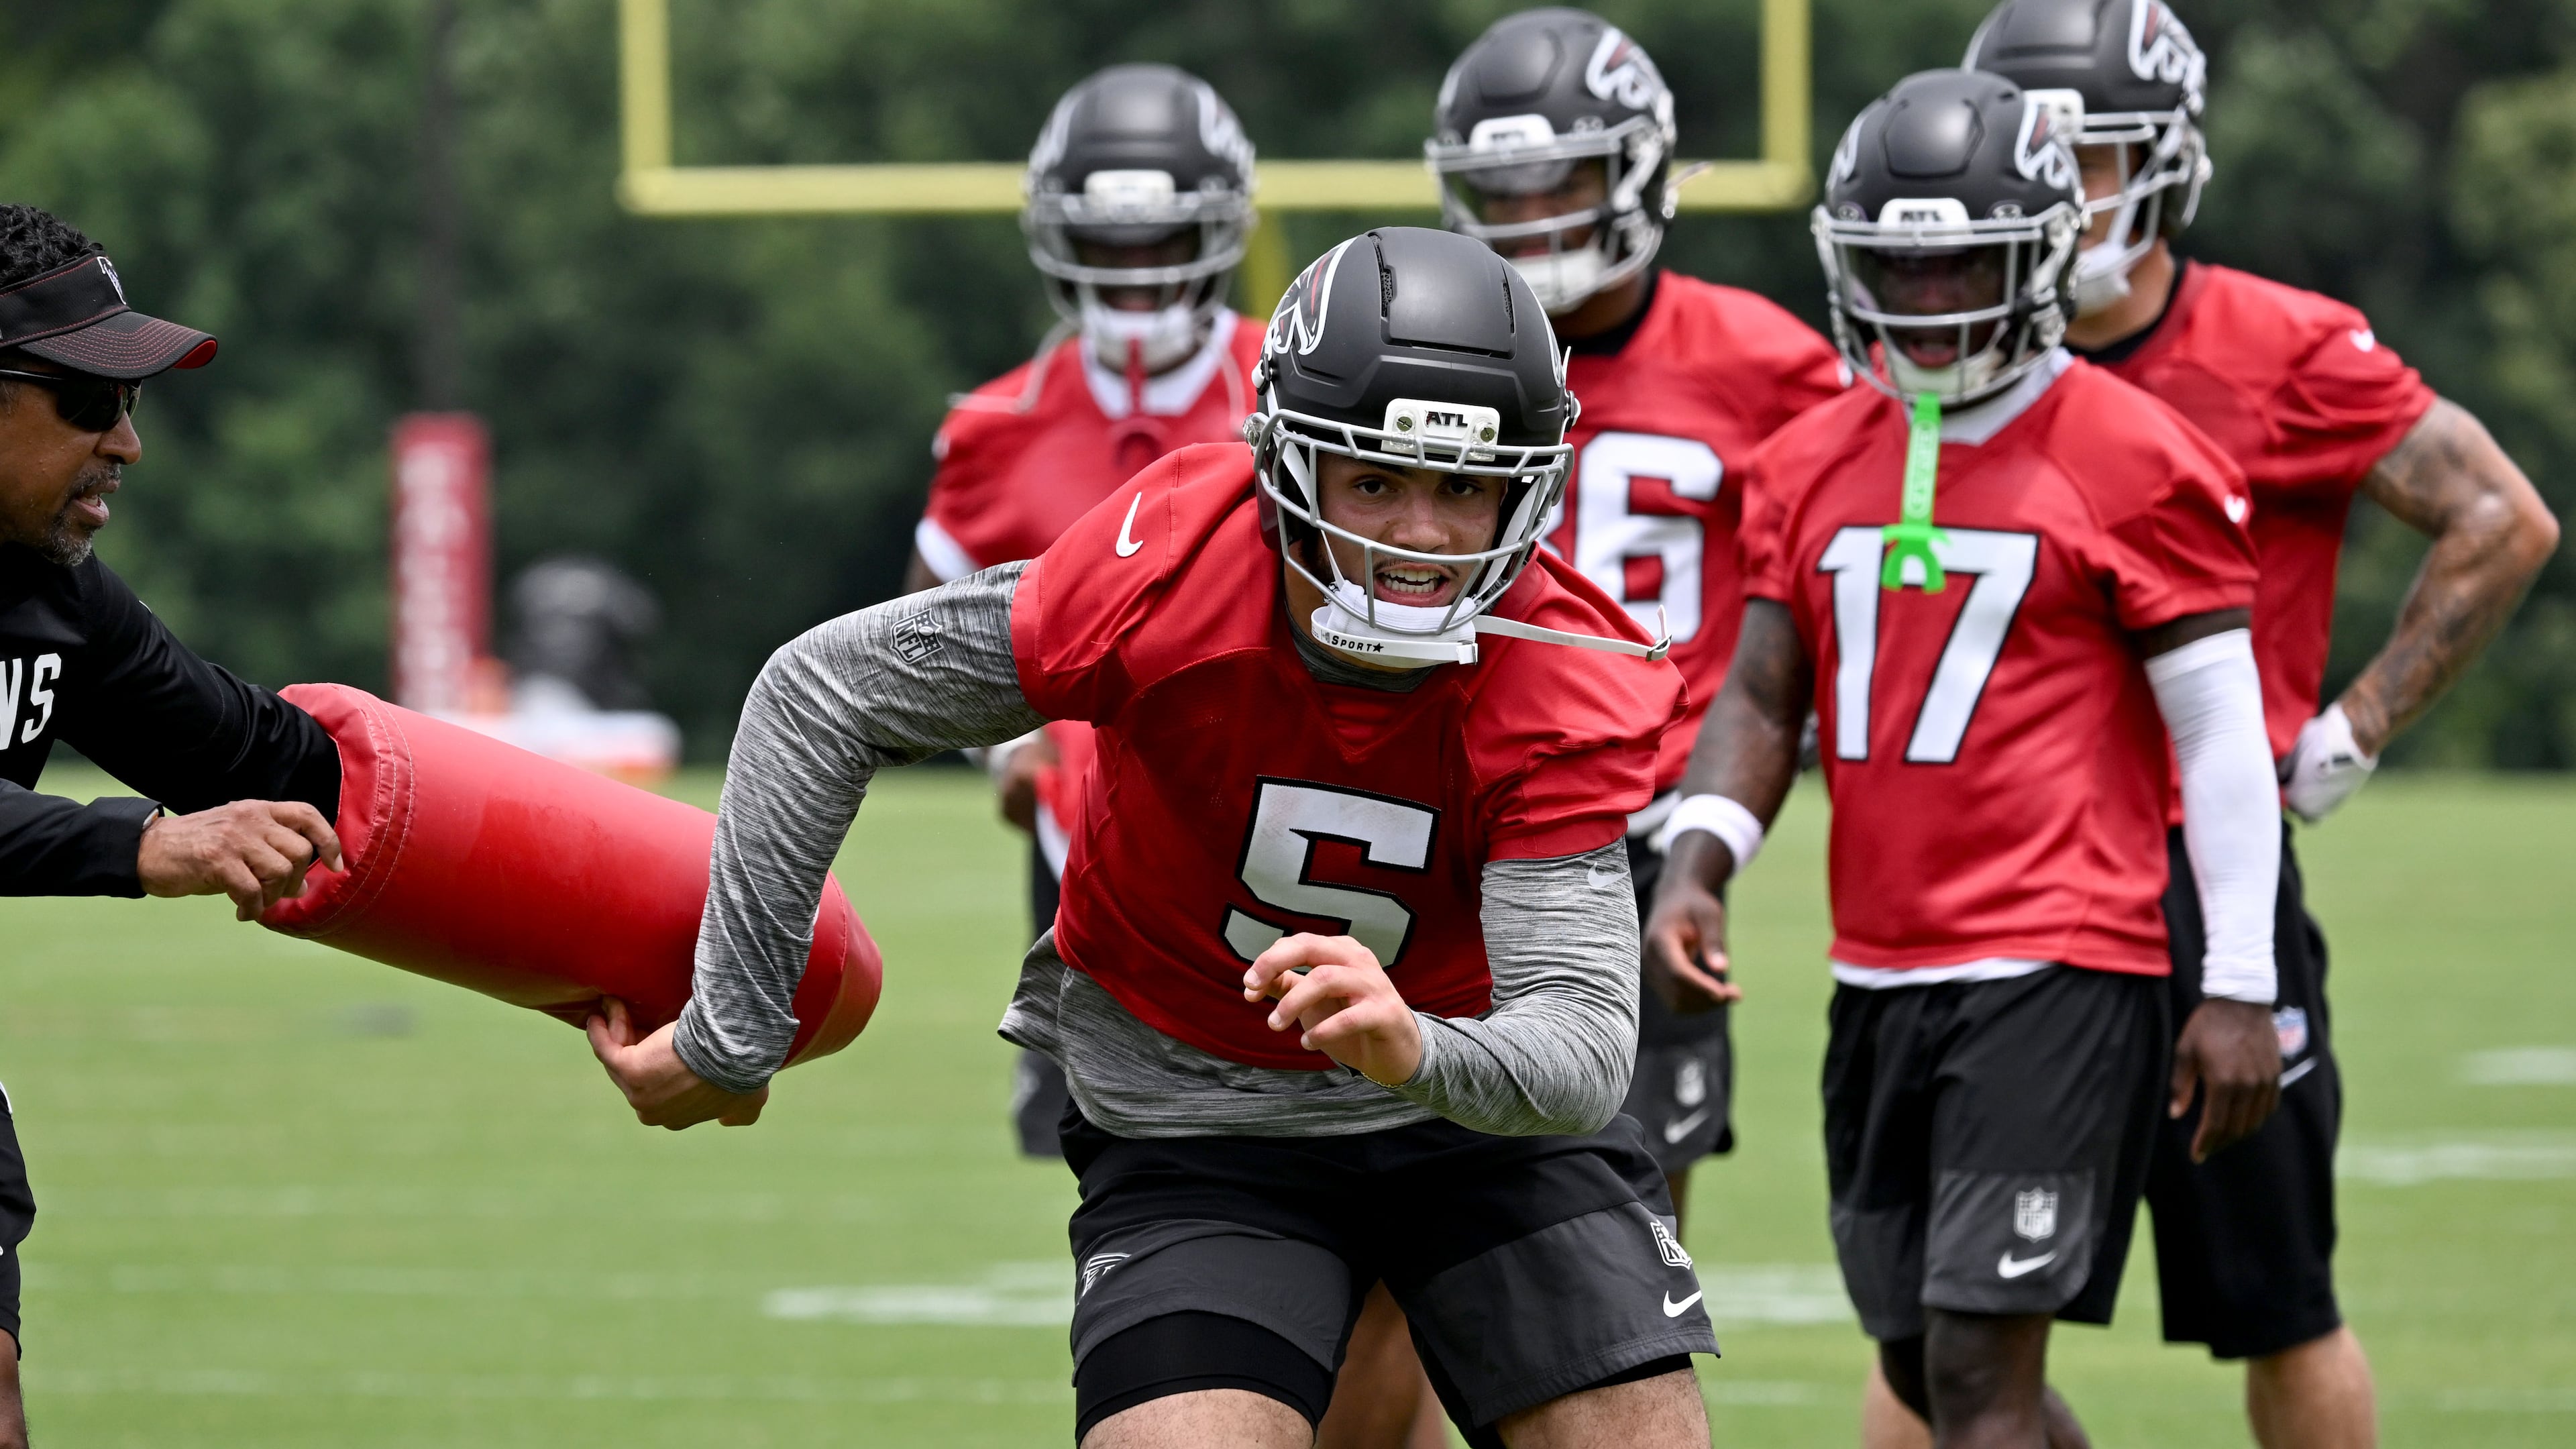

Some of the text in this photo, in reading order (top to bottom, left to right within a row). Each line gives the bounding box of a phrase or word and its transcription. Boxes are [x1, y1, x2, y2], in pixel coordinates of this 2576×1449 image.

[1424, 410, 1468, 427] ATL
[895, 619, 922, 659] NFL
[1816, 525, 2039, 765] 17
[1218, 774, 1442, 976] 5
